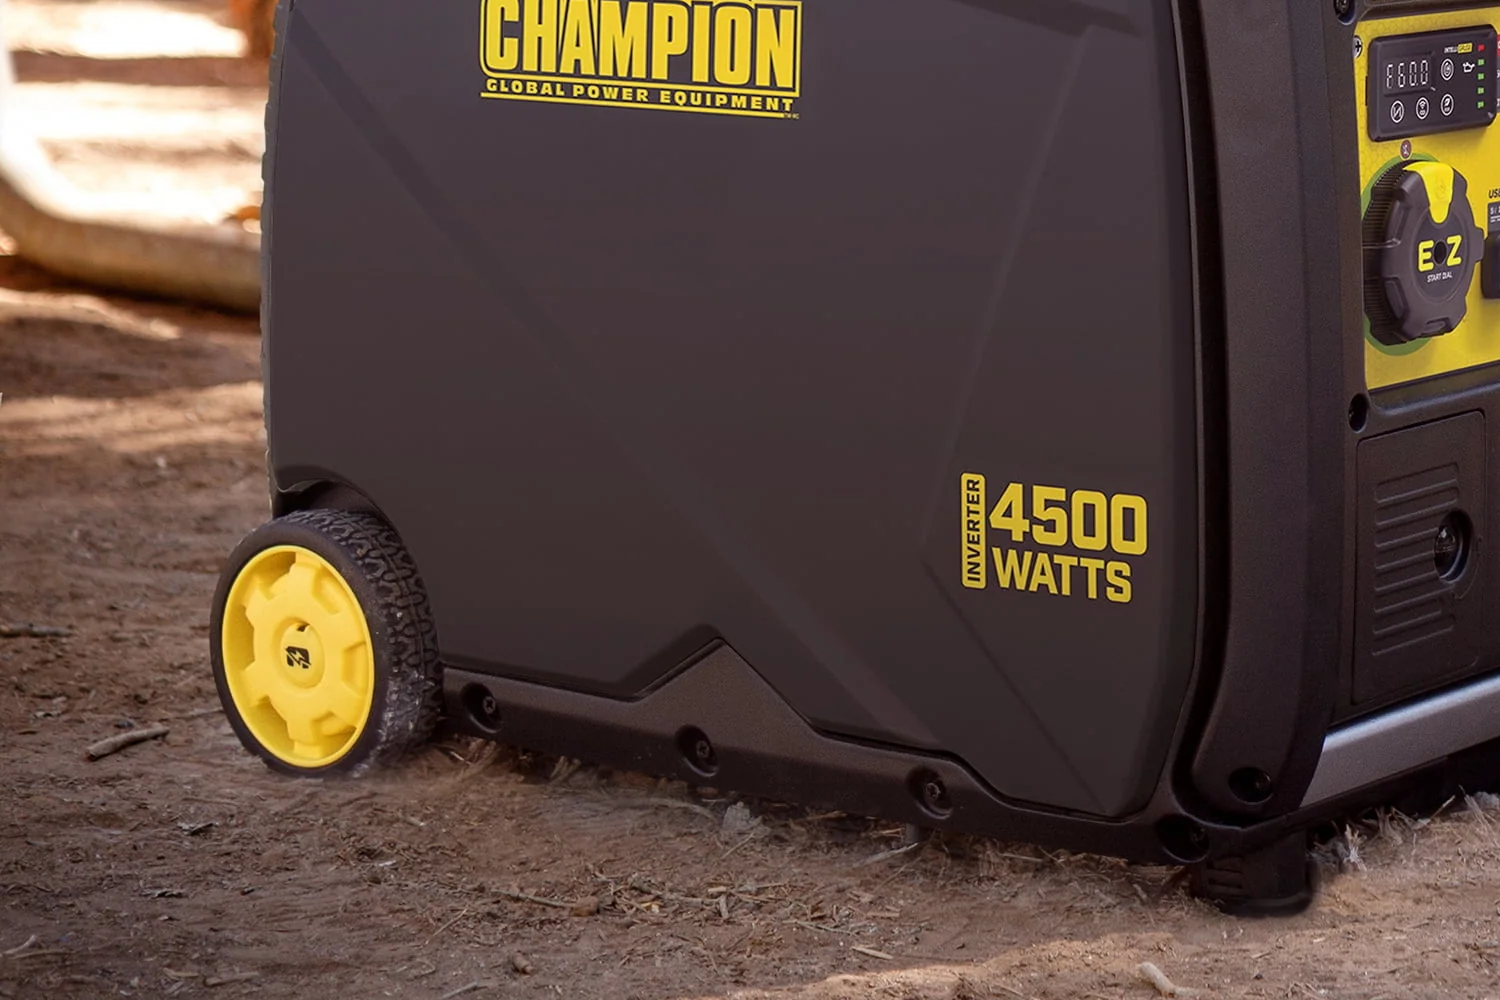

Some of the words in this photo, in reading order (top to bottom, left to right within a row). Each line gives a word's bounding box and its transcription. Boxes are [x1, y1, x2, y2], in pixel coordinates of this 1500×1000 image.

[486, 78, 566, 97] GLOBAL
[572, 84, 649, 103] POWER
[659, 89, 794, 112] EQUIPMENT
[1426, 272, 1442, 283] START
[966, 478, 981, 582] INVERTER
[988, 482, 1148, 556] 4500
[991, 547, 1132, 603] WATTS
